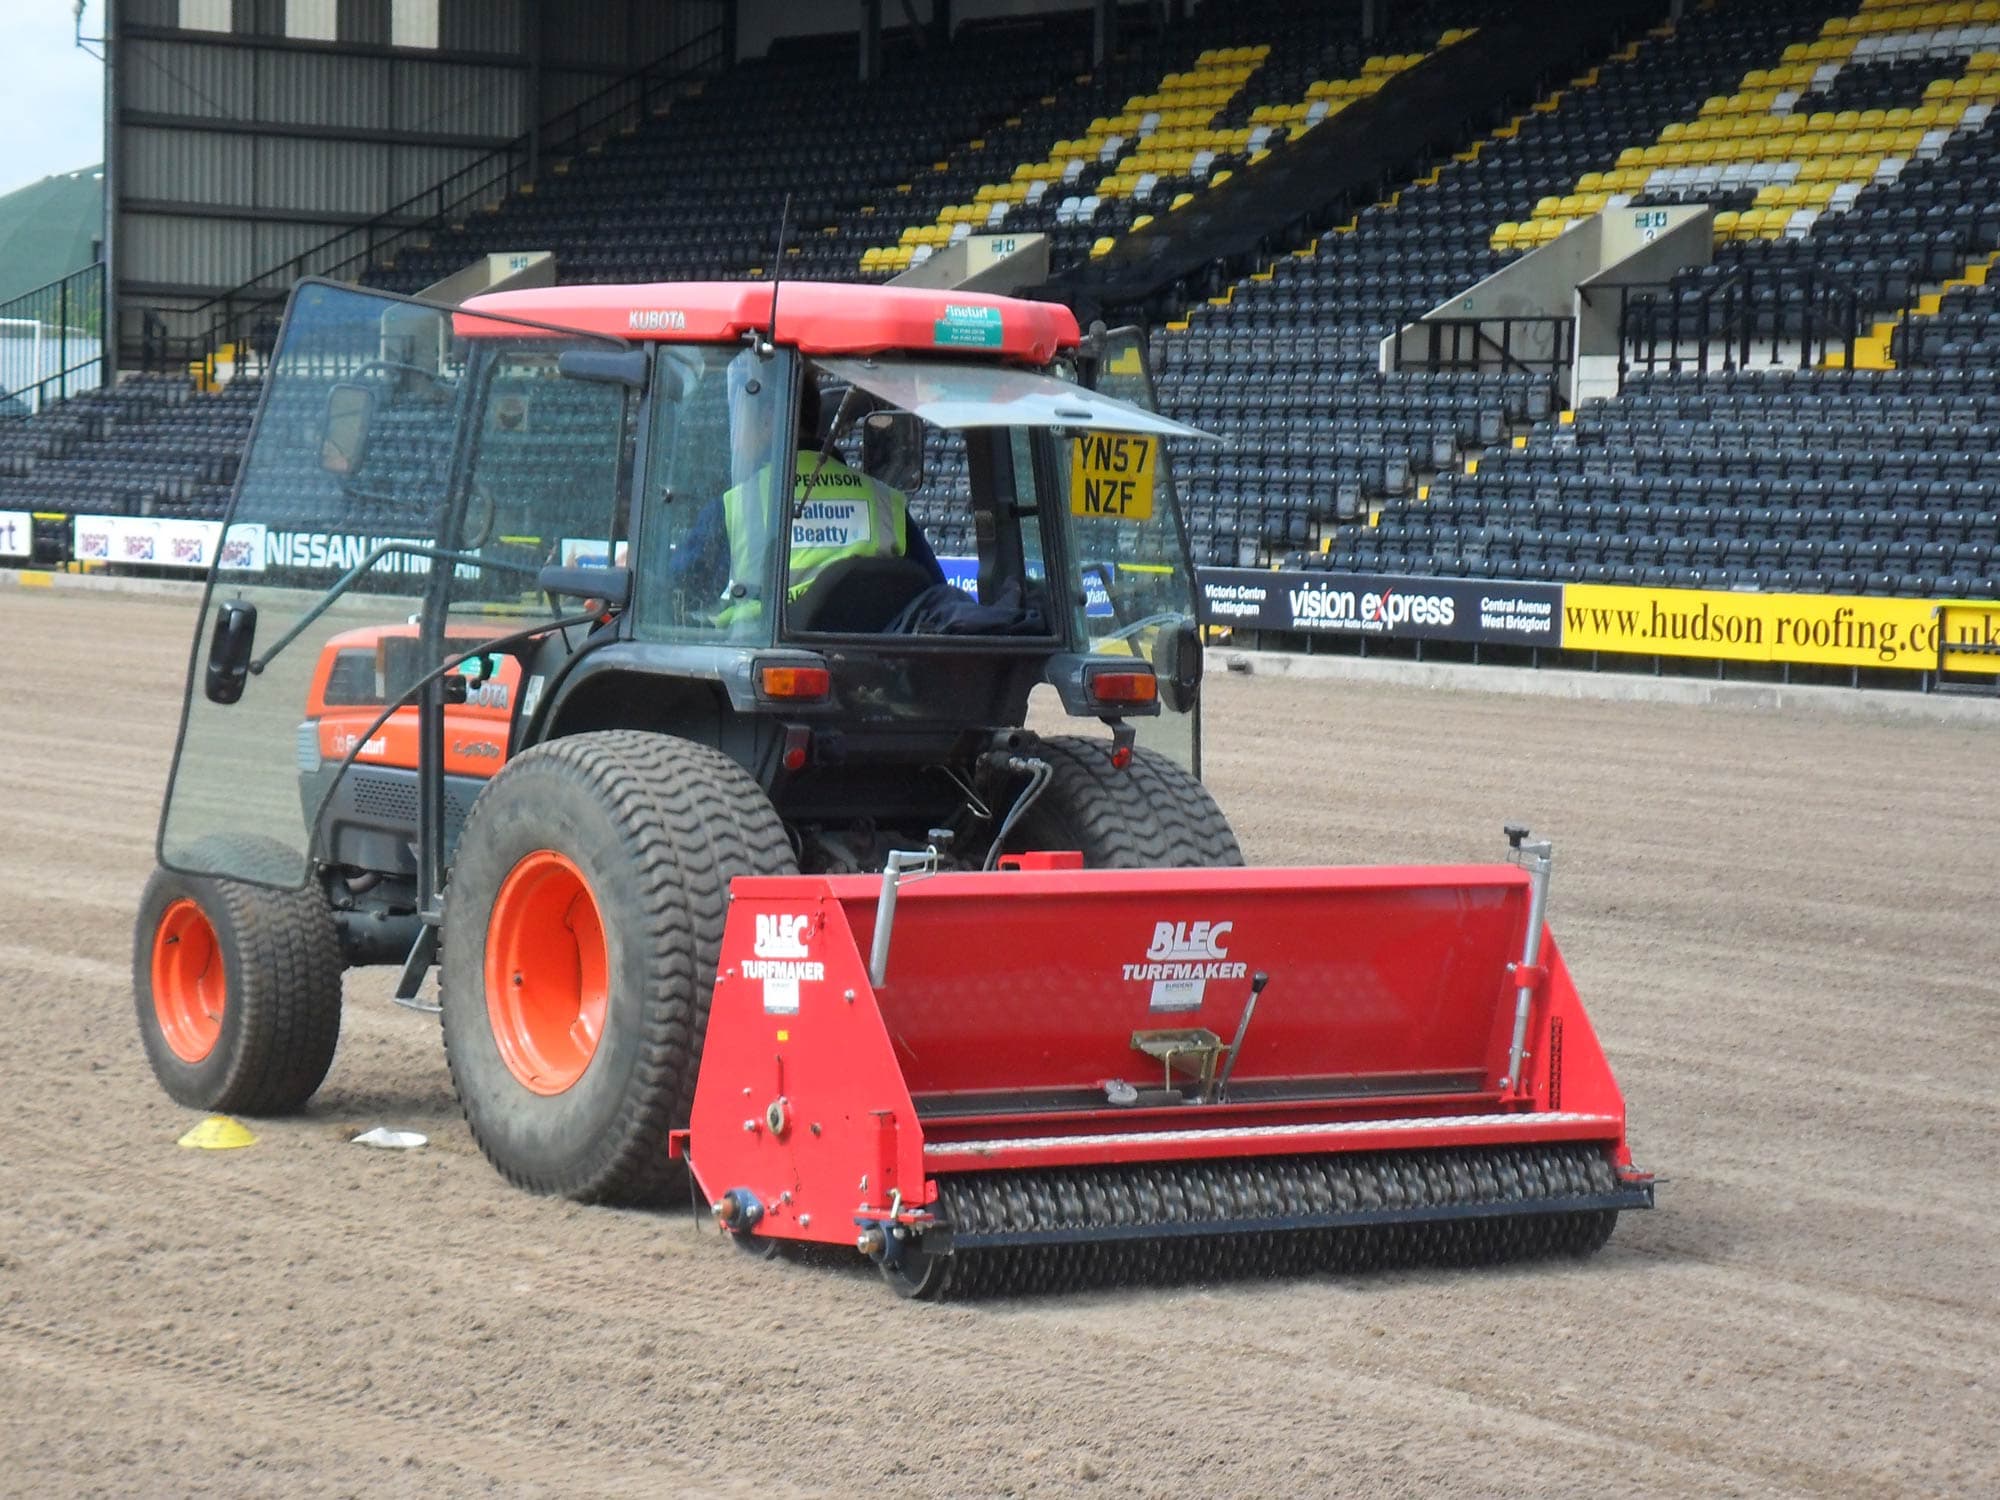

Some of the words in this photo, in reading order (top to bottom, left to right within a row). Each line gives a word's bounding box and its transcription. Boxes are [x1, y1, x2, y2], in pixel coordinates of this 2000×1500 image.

[629, 311, 686, 330] KUBOTA
[1080, 436, 1149, 473] YN57
[1085, 478, 1136, 514] NZF
[793, 525, 848, 544] Beatty
[266, 531, 366, 569] NISSAN
[1205, 584, 1237, 599] Victoria
[1238, 585, 1267, 600] Centre
[1211, 600, 1260, 618] Nottingham
[1361, 586, 1455, 630] express
[1481, 597, 1515, 613] Central
[1516, 599, 1551, 615] Avenue
[1481, 614, 1505, 629] West
[1506, 615, 1551, 633] Bridgford
[1565, 600, 1763, 645] www.hudson
[754, 914, 809, 958] BLEC
[1146, 921, 1234, 960] BLEC
[741, 960, 824, 981] TURFMAKER
[1122, 962, 1247, 981] TURFMAKER
